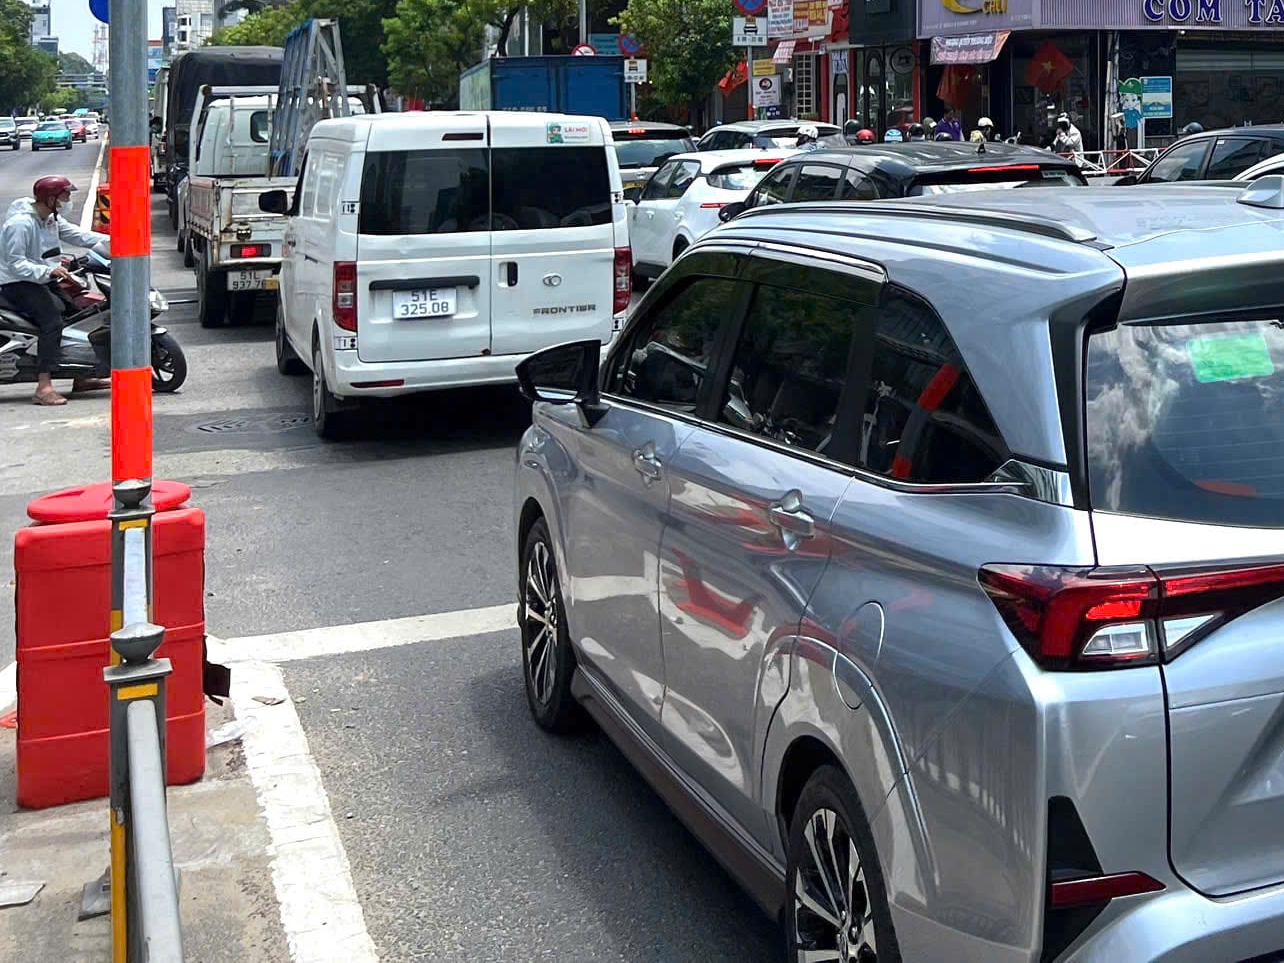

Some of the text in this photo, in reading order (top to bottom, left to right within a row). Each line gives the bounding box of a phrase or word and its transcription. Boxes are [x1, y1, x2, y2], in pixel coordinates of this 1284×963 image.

[412, 289, 438, 302] 51E
[401, 301, 449, 316] 325.08
[533, 304, 596, 315] FRONTIER
